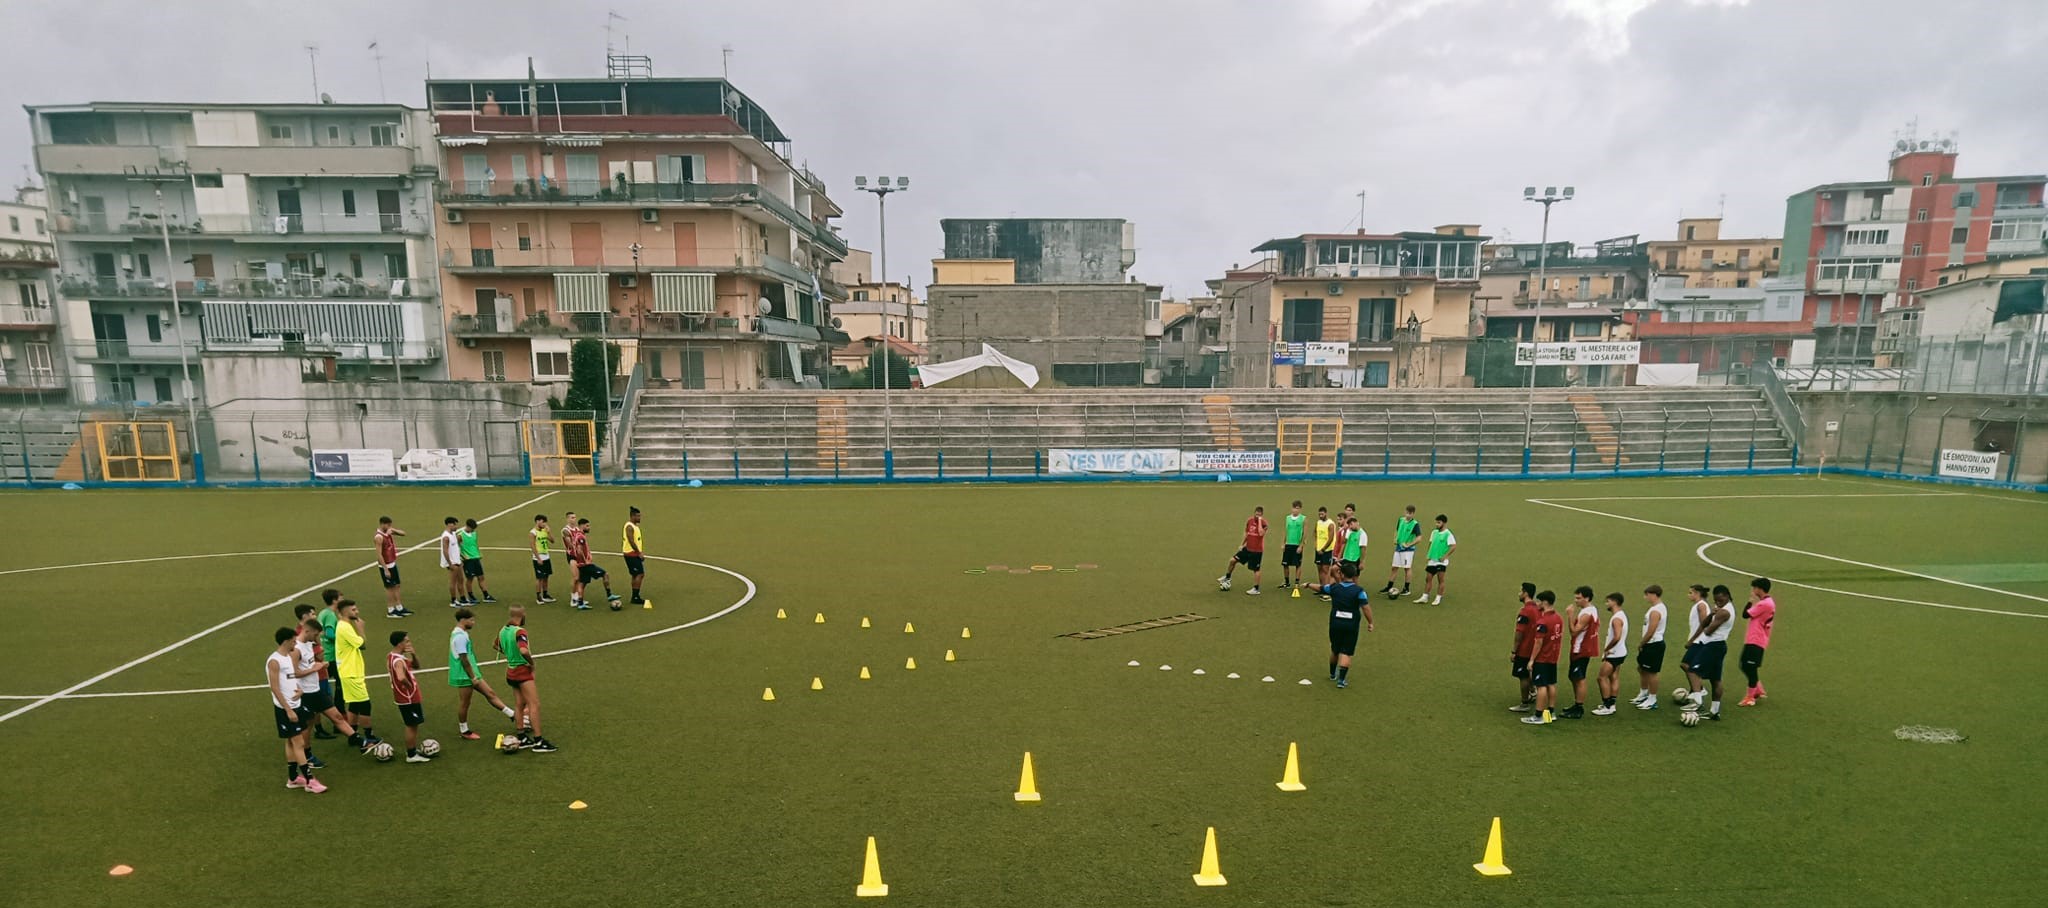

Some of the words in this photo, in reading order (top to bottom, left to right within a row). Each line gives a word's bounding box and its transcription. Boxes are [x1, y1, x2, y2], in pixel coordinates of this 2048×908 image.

[1610, 353, 1627, 361] FARE
[1067, 453, 1097, 470] YES
[1102, 453, 1126, 469] WE
[1131, 452, 1164, 469] CAN
[1943, 452, 1951, 461] LE
[1951, 453, 1980, 463] EMOZIONI
[1980, 456, 1997, 464] NON
[1945, 464, 1968, 472] HANNO
[1968, 465, 1990, 474] TEMPO
